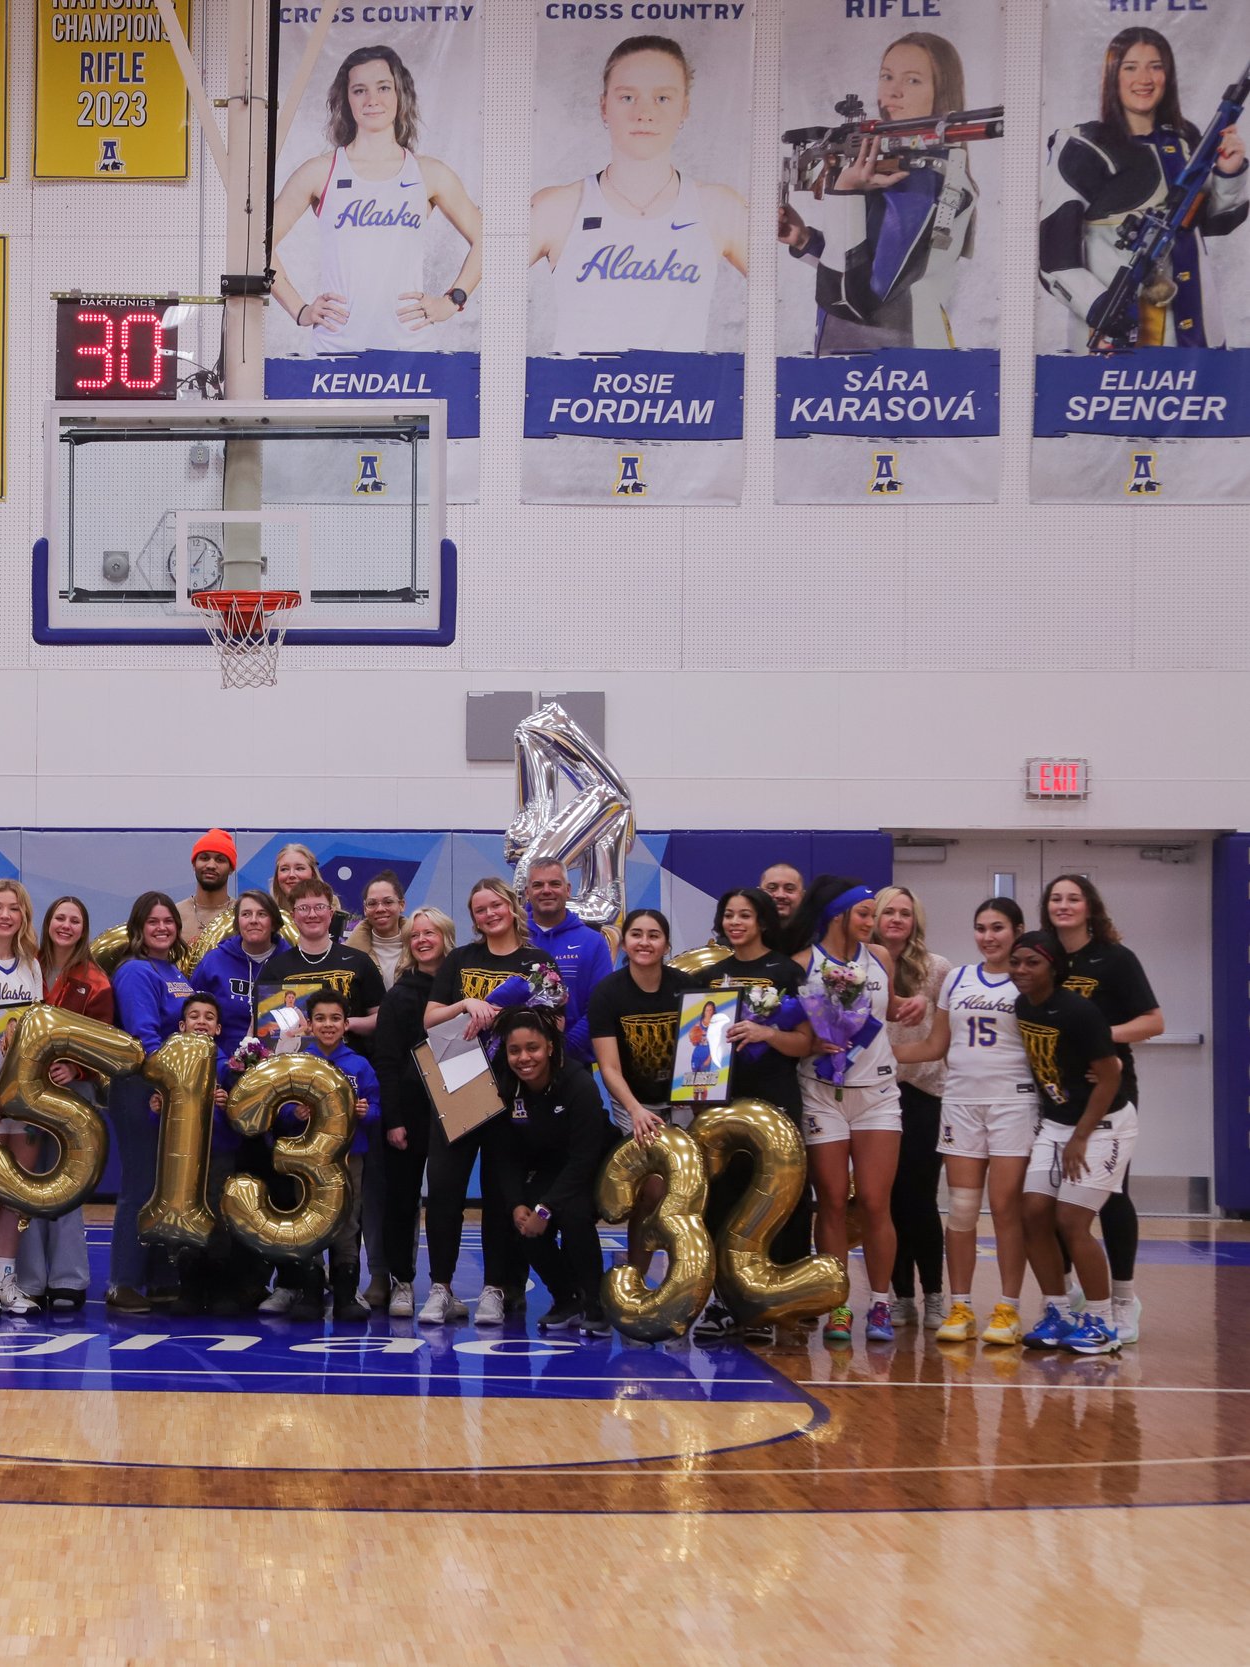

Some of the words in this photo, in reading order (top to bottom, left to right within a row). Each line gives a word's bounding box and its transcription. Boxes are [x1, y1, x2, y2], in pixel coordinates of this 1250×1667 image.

[362, 6, 474, 22] COUNTRY
[546, 4, 623, 20] CROSS
[631, 4, 744, 20] COUNTRY
[845, 0, 942, 17] RIFLE
[51, 14, 170, 43] CHAMPION
[80, 51, 145, 83] RIFLE
[76, 91, 147, 128] 2023
[334, 200, 421, 229] Alaska
[576, 244, 701, 284] Alaska
[80, 299, 156, 307] DAKTRONICS
[77, 314, 161, 388] 30
[312, 374, 432, 393] KENDALL
[593, 374, 674, 393] ROSIE
[845, 365, 929, 391] SÁRA
[1100, 370, 1196, 390] ELIJAH
[550, 399, 714, 424] FORDHAM
[790, 391, 976, 422] KARASOVÁ
[1066, 396, 1227, 420] SPENCER
[1040, 763, 1079, 791] EXIT
[954, 994, 1015, 1014] Alaska
[967, 1016, 997, 1047] 15
